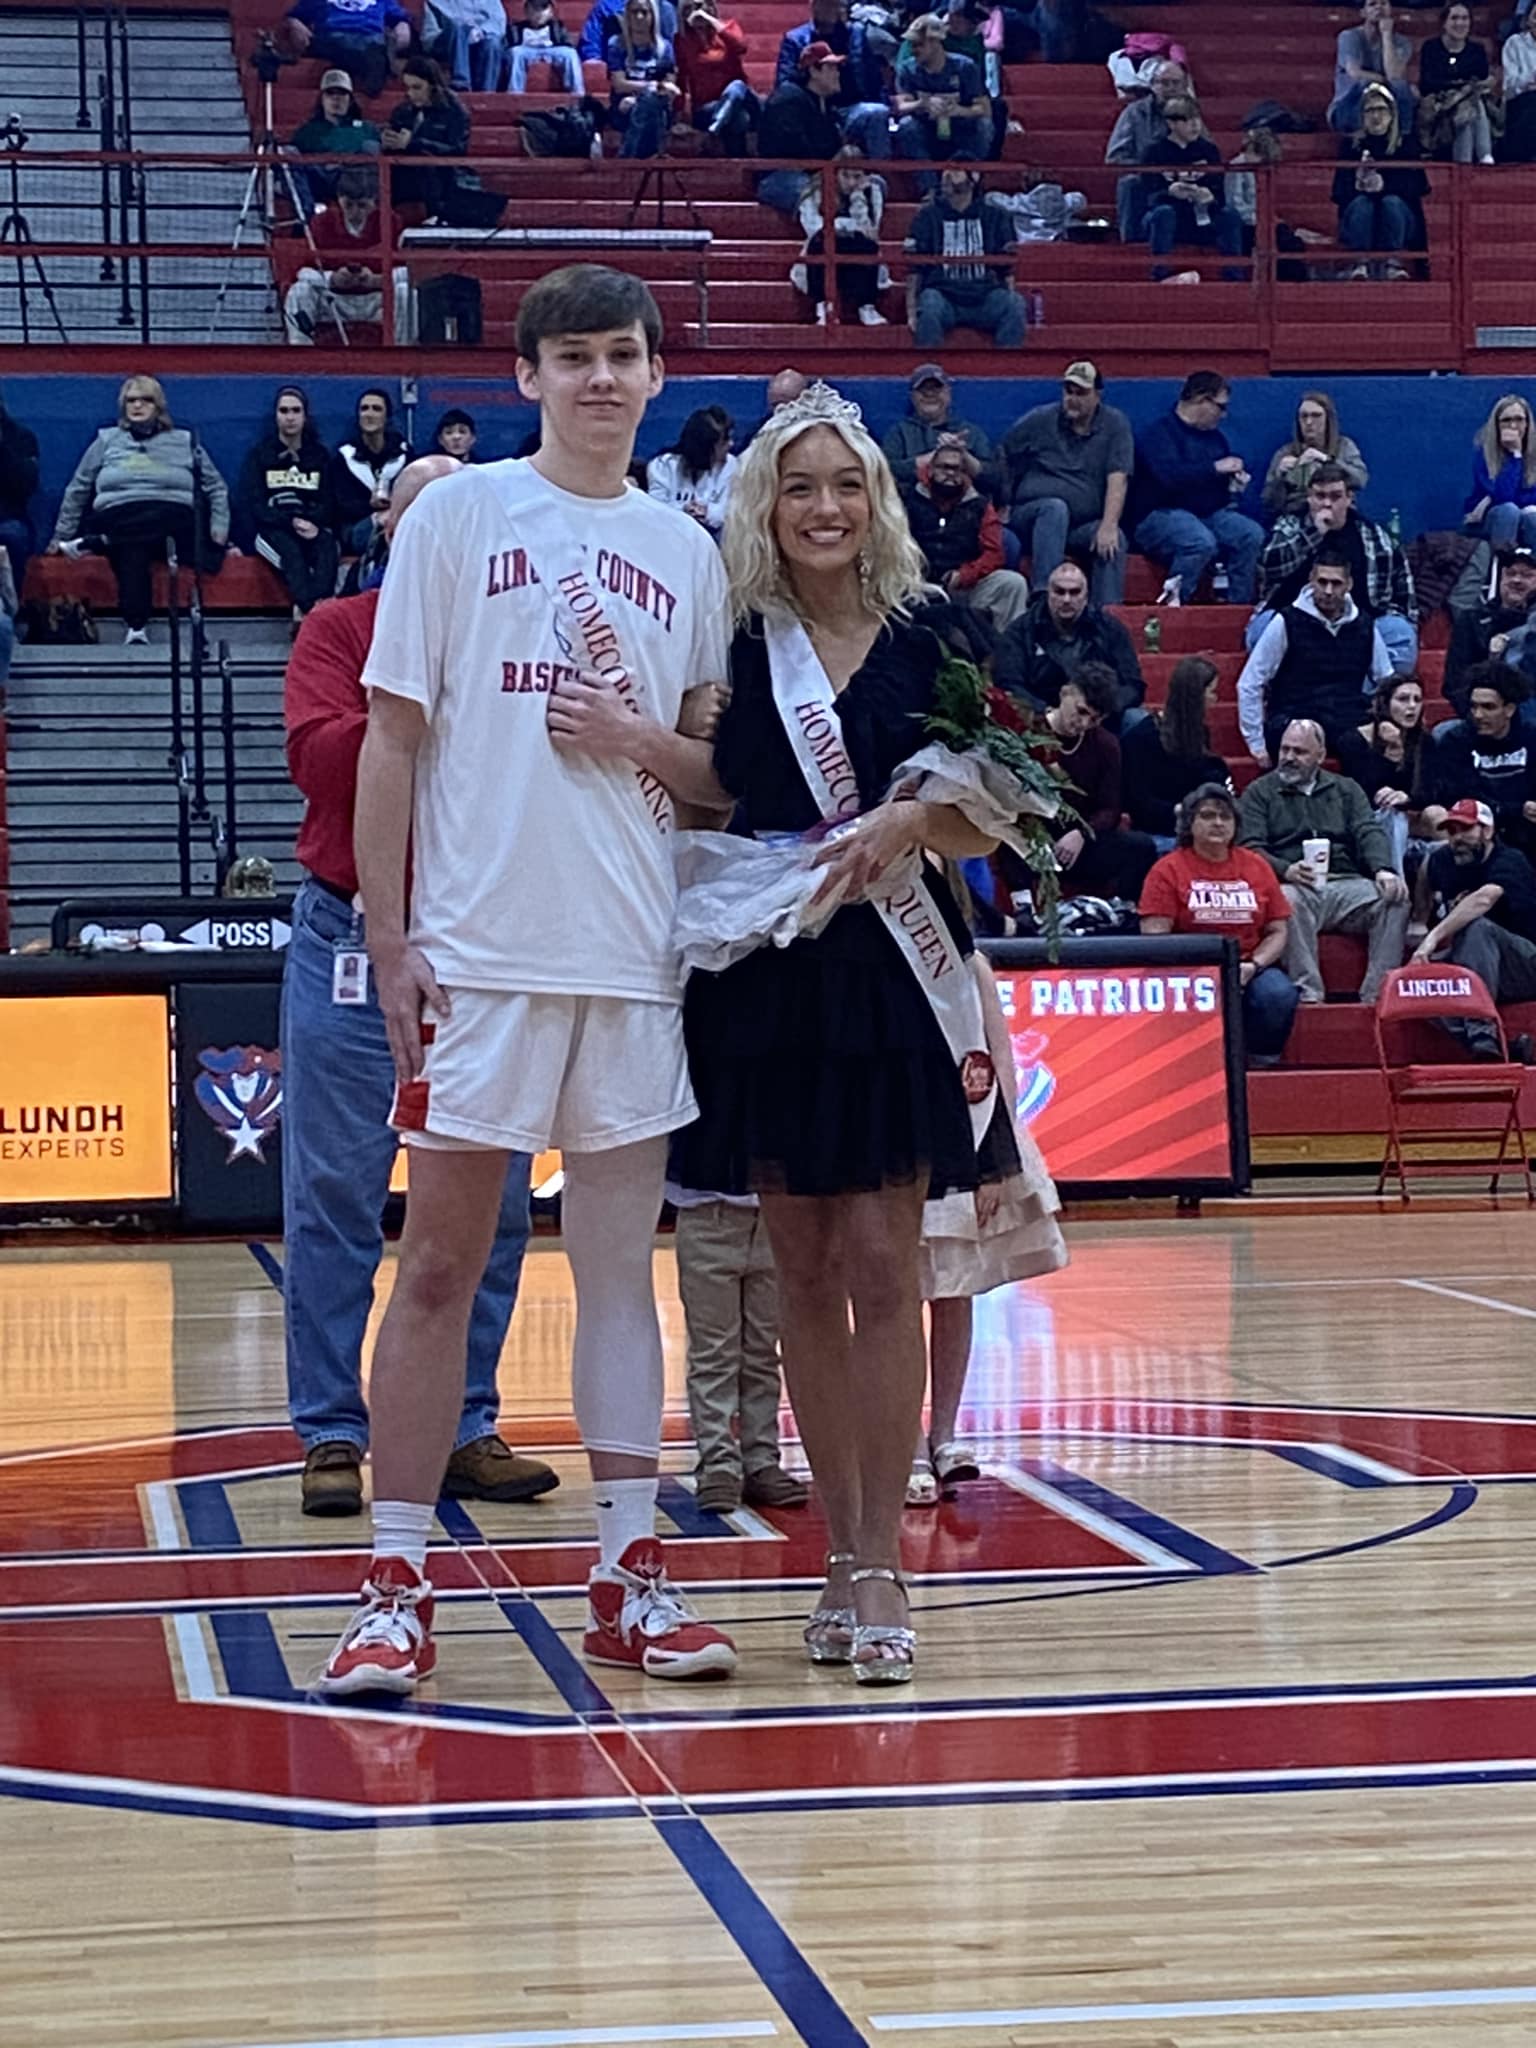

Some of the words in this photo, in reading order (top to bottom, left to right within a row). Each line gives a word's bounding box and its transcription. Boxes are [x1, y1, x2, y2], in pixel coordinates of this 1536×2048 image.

[597, 548, 677, 633] COUNTY
[795, 700, 861, 815] HOMECO
[884, 885, 953, 980] QUEEN
[212, 922, 270, 946] POSS
[1031, 976, 1216, 1016] PATRIOTS
[1397, 978, 1472, 997] LINCOLN
[0, 1104, 123, 1134] LUNDH
[1, 1137, 125, 1160] EXPERTS
